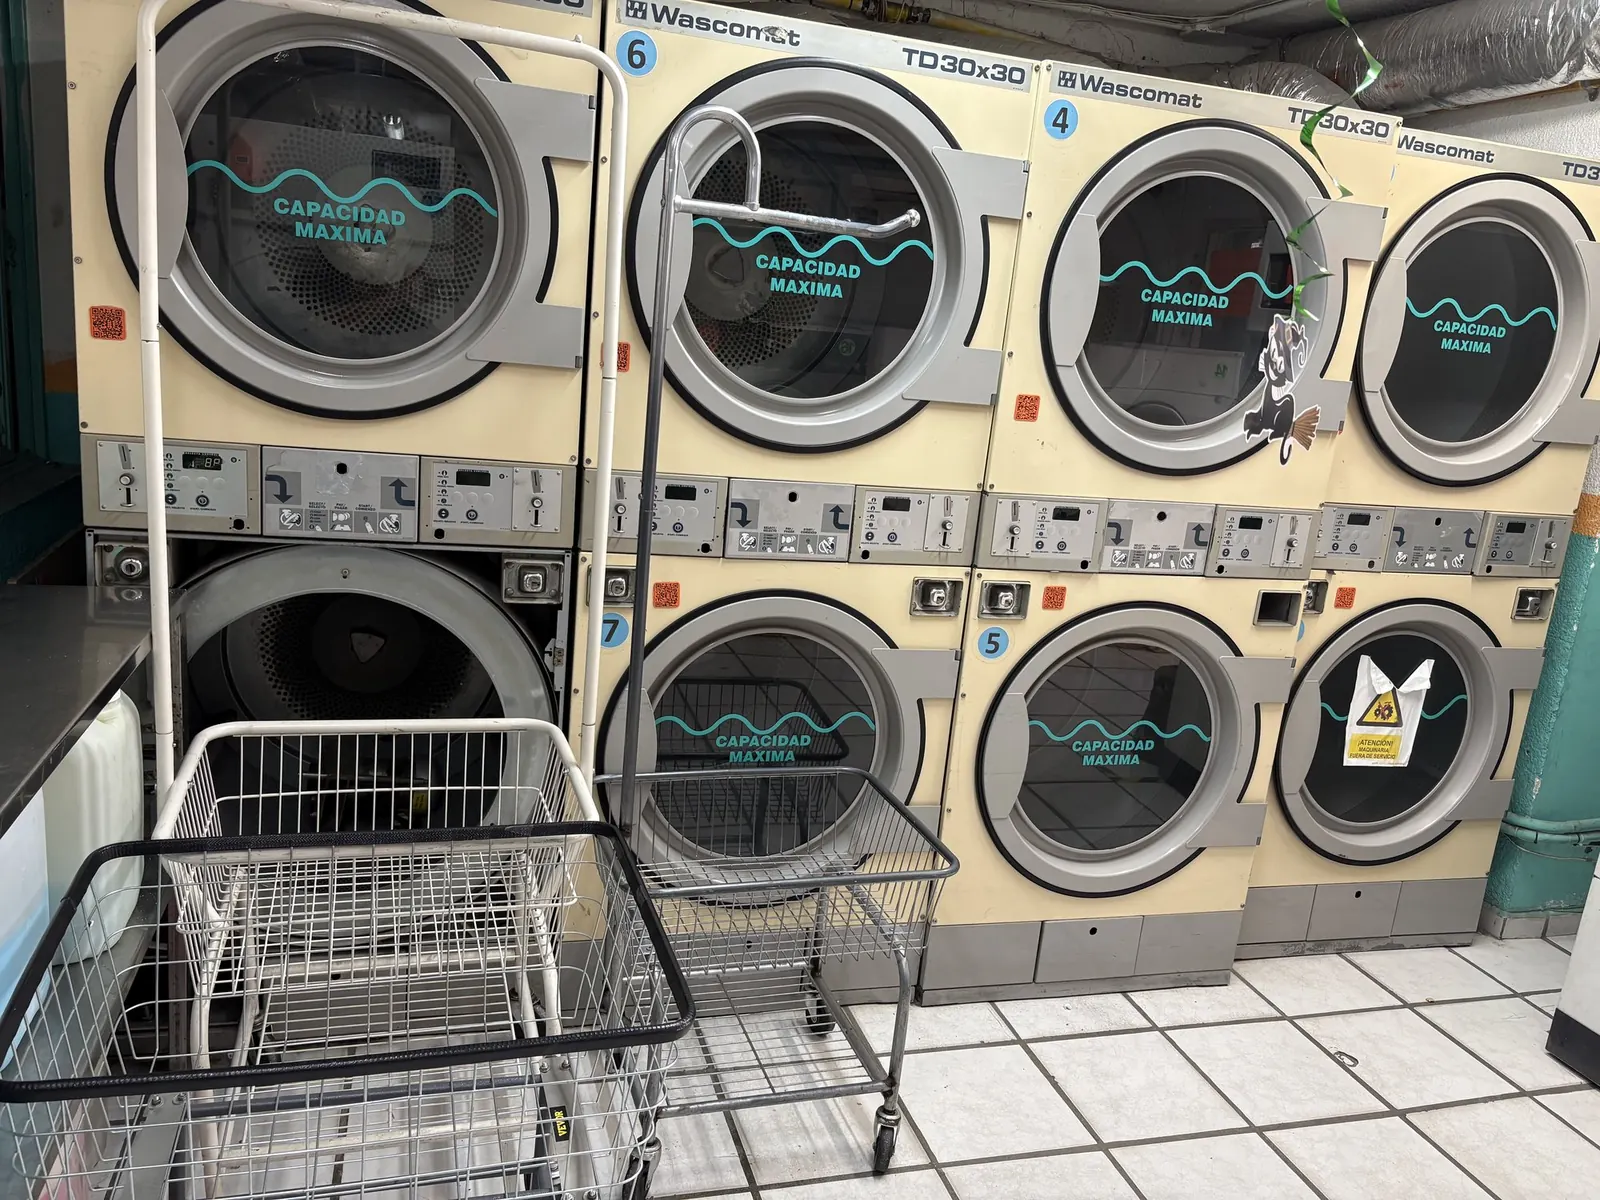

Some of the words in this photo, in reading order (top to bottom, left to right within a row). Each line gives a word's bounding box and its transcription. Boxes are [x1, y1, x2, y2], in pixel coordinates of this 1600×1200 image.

[627, 39, 646, 69] 6
[902, 47, 1026, 85] TD30x30
[1080, 73, 1203, 109] Wascomat
[1052, 107, 1069, 134] 4
[1398, 134, 1495, 164] Wascomat
[273, 197, 406, 226] CAPACIDAD
[295, 221, 388, 245] MAXIMA
[755, 253, 861, 280] CAPACIDAD
[769, 276, 844, 299] MAXIMA
[1140, 287, 1230, 311] CAPACIDAD
[1151, 308, 1214, 328] MAXIMA
[1433, 319, 1507, 339] CAPACIDAD
[1440, 337, 1492, 355] MAXIMA
[603, 619, 619, 643] 7
[985, 632, 1000, 656] 5
[715, 734, 812, 748] CAPACIDAD
[1072, 740, 1155, 752] CAPACIDAD
[728, 749, 796, 763] MAXIMA
[1081, 754, 1140, 766] MAXIMA
